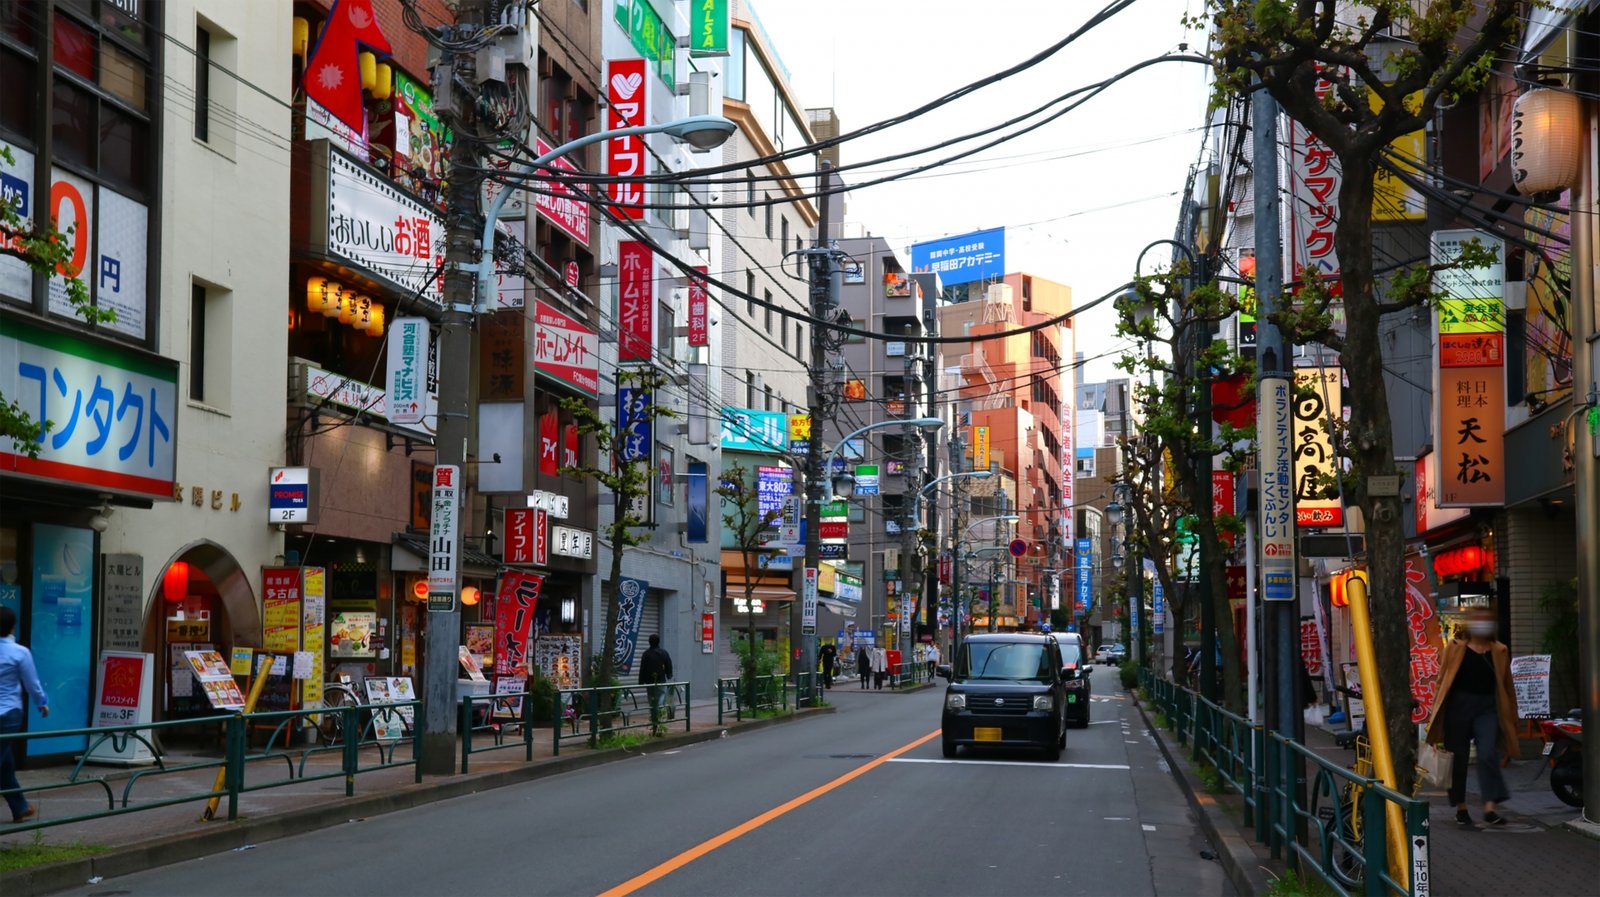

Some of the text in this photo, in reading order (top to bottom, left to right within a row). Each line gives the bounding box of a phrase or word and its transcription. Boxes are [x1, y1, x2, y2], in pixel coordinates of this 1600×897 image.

[333, 213, 431, 260] おいしい お酒
[101, 254, 121, 294] 円
[931, 252, 1001, 272] 早稲田アカデミー
[623, 251, 641, 350] ホームメイト
[401, 322, 416, 401] 河合塾マナビス
[535, 327, 588, 365] ホームメイト
[1456, 380, 1472, 408] 料理
[1475, 381, 1488, 408] 日本
[18, 361, 170, 468] コンタクト
[1275, 384, 1289, 538] ボランティア活動センター
[1294, 390, 1325, 503] 日高屋
[1456, 417, 1491, 485] 天松
[274, 490, 305, 499] PROMISE
[1264, 472, 1277, 538] こくぶんじ
[282, 510, 296, 520] 2F
[432, 536, 452, 572] 山田
[514, 510, 527, 562] アイフル
[266, 587, 299, 600] 多古屋
[168, 625, 208, 637] 一番搾り
[105, 694, 136, 705] ハウスメイト
[120, 708, 135, 720] 3F
